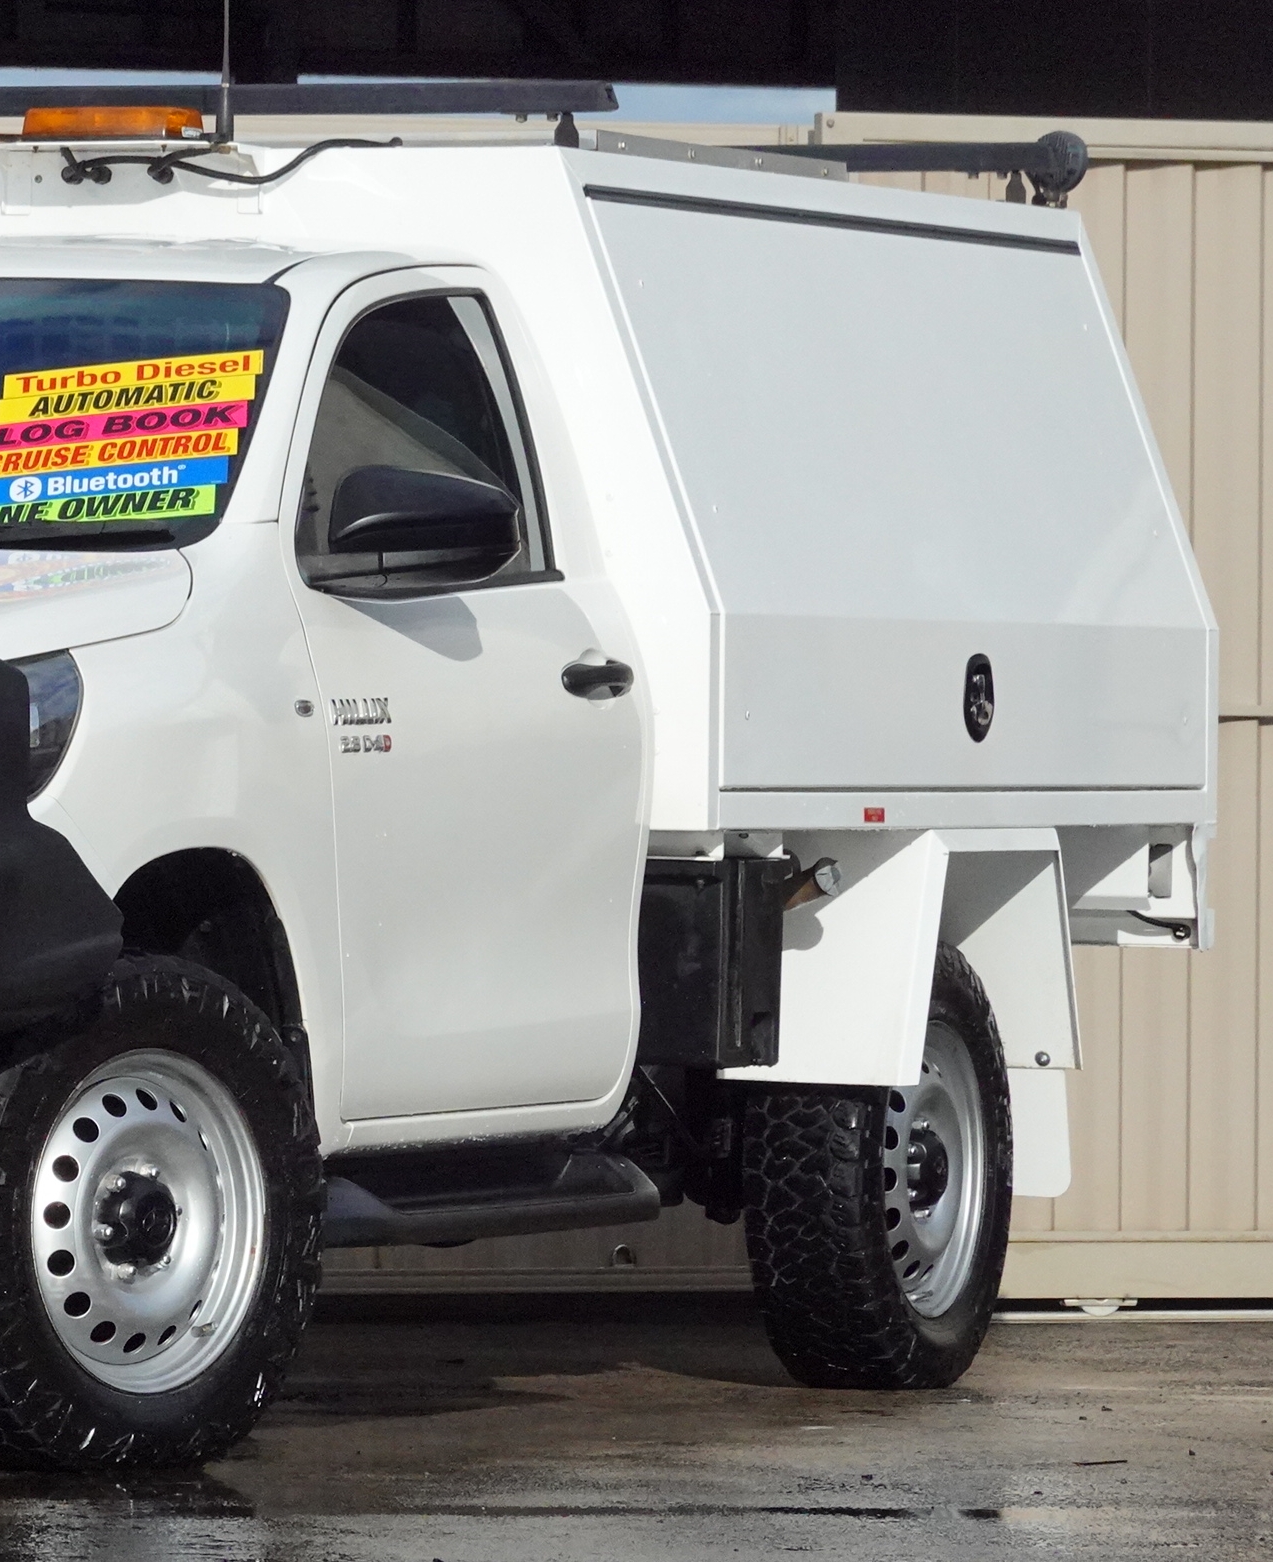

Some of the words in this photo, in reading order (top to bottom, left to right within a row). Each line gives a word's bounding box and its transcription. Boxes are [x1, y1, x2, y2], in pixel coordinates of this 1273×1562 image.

[16, 371, 121, 394] Turbo
[136, 356, 251, 381] Diesel
[28, 379, 222, 418] AUTOMATIC
[102, 404, 239, 434] BOOK
[97, 432, 229, 463] CONTROL
[47, 464, 178, 496] Bluetooth
[57, 487, 198, 520] OWNER
